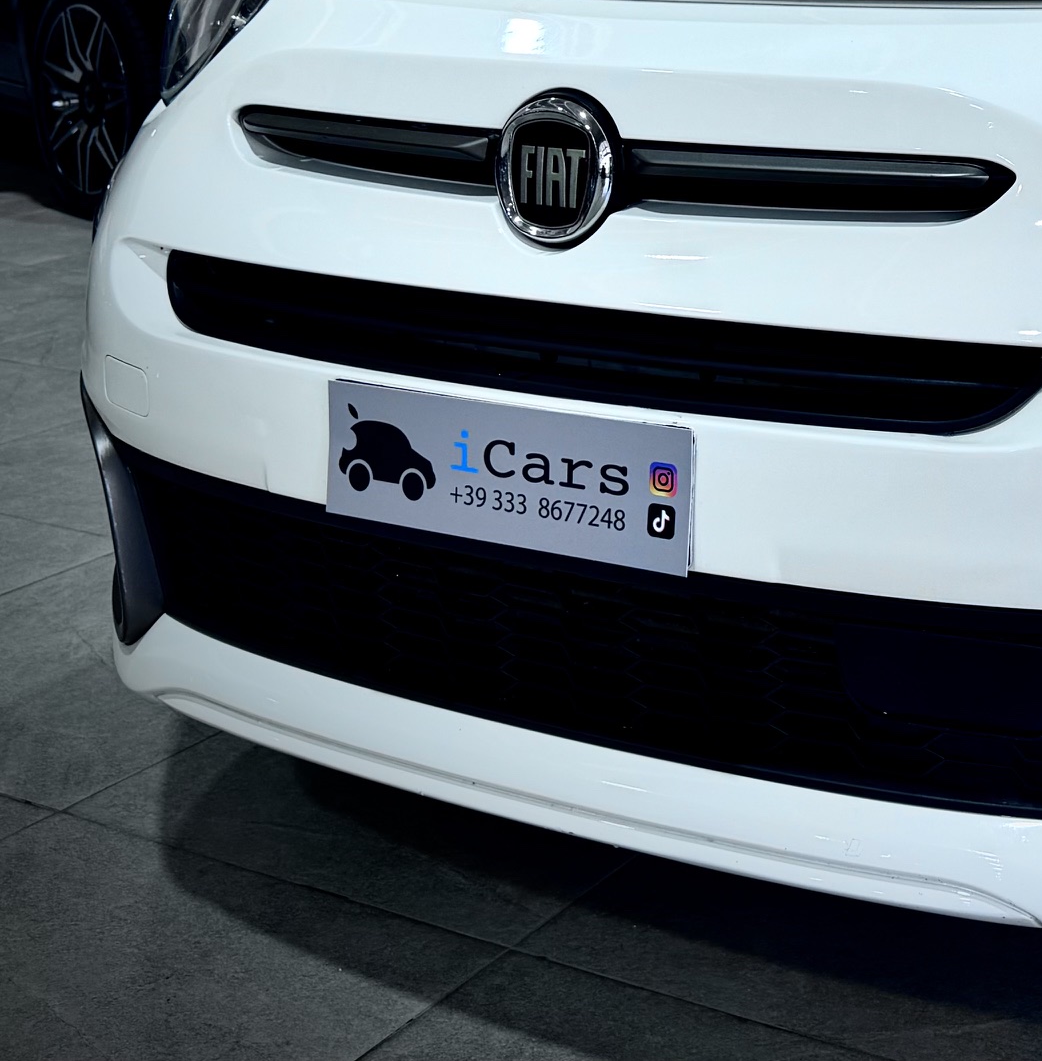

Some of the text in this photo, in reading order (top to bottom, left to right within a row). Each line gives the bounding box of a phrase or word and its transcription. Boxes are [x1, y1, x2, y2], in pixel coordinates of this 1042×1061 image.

[520, 144, 586, 209] FIAT
[450, 429, 630, 496] iCars
[450, 485, 626, 531] +39 333 8677248
